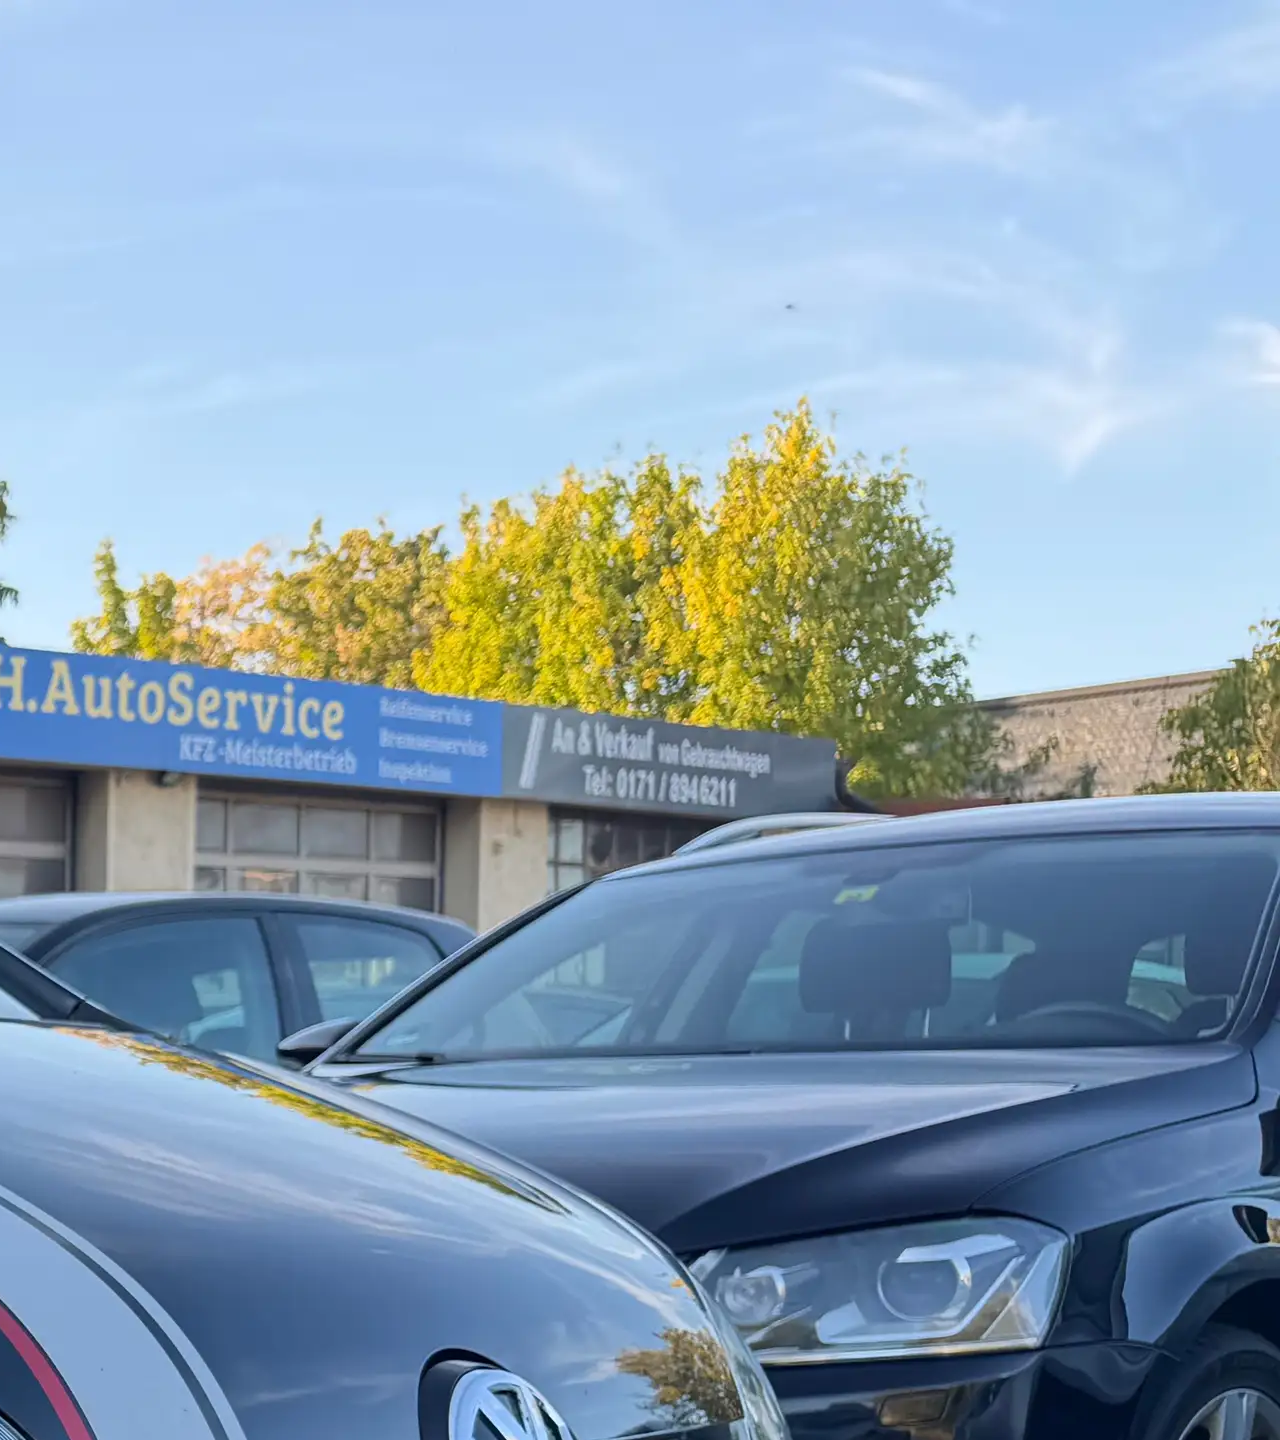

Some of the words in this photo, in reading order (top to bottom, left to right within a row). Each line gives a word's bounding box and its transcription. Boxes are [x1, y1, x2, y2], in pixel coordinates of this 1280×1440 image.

[378, 726, 489, 758] Bremsenservice
[551, 717, 575, 754] An
[577, 719, 590, 756] &
[594, 721, 655, 762] Verkauf
[657, 742, 680, 766] von
[680, 738, 771, 779] Gebrauchtwagen
[378, 756, 453, 785] Inspektion
[616, 767, 656, 801] 0171
